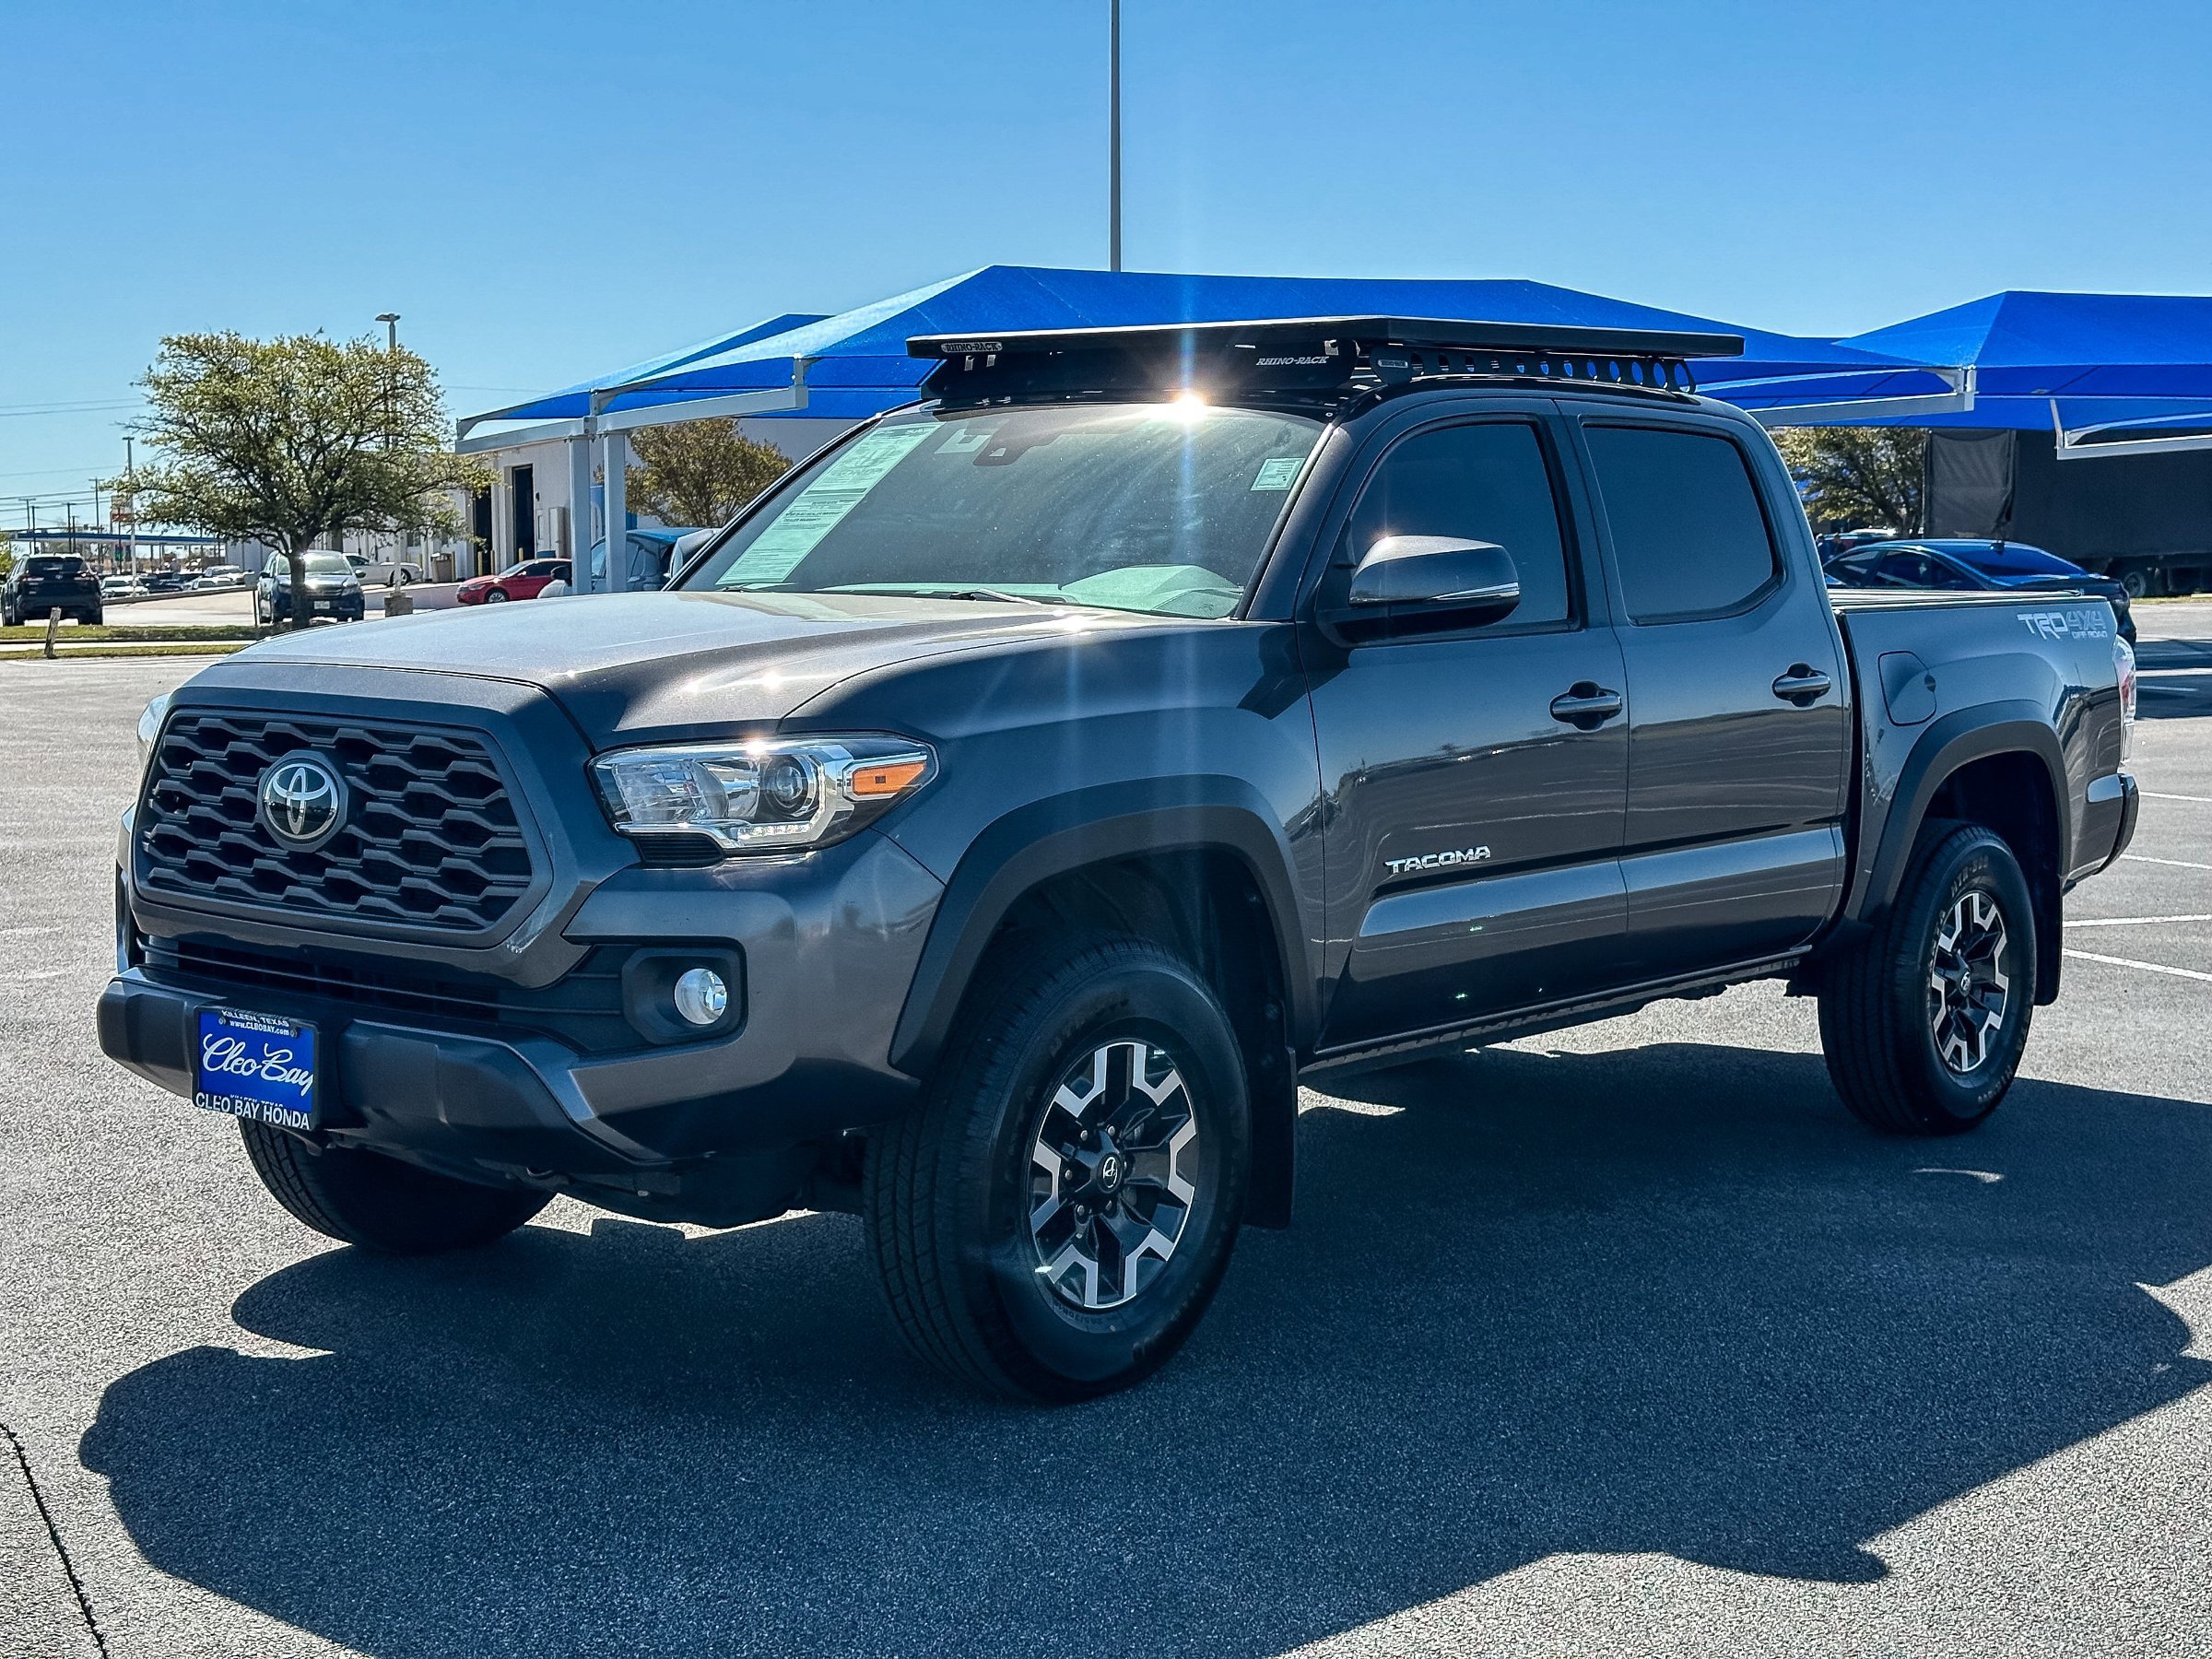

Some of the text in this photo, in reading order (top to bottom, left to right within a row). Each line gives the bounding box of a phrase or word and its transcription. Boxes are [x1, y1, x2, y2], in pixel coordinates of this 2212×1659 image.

[944, 341, 999, 352] RHINO-RACK
[1255, 356, 1330, 366] RHINO-RACK
[2017, 610, 2106, 641] TRD 4X4
[2071, 630, 2108, 640] OFF ROAD
[1384, 845, 1491, 875] TACOMA
[229, 1020, 289, 1036] www.CLEOBAY.com
[260, 1017, 289, 1028] TEXAS
[202, 1033, 315, 1097] Cleo Bay
[195, 1092, 231, 1113] CLEO
[234, 1098, 260, 1120] BAY
[263, 1105, 311, 1131] HONDA
